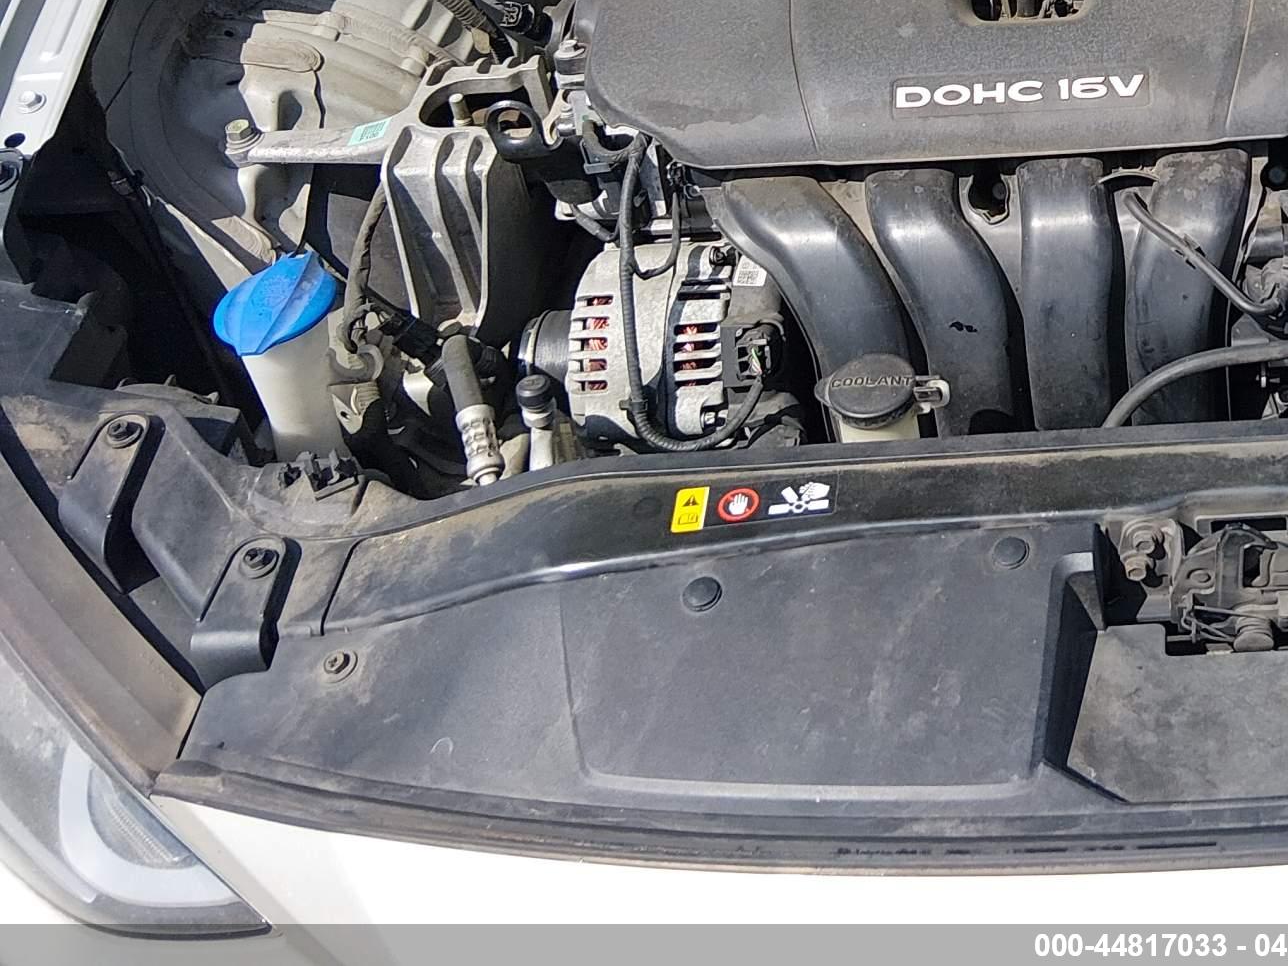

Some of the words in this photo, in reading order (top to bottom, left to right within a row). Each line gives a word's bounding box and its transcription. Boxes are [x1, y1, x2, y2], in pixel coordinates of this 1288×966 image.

[895, 80, 1042, 110] DOHC
[1059, 74, 1145, 101] 16V
[831, 376, 913, 389] COOLANT
